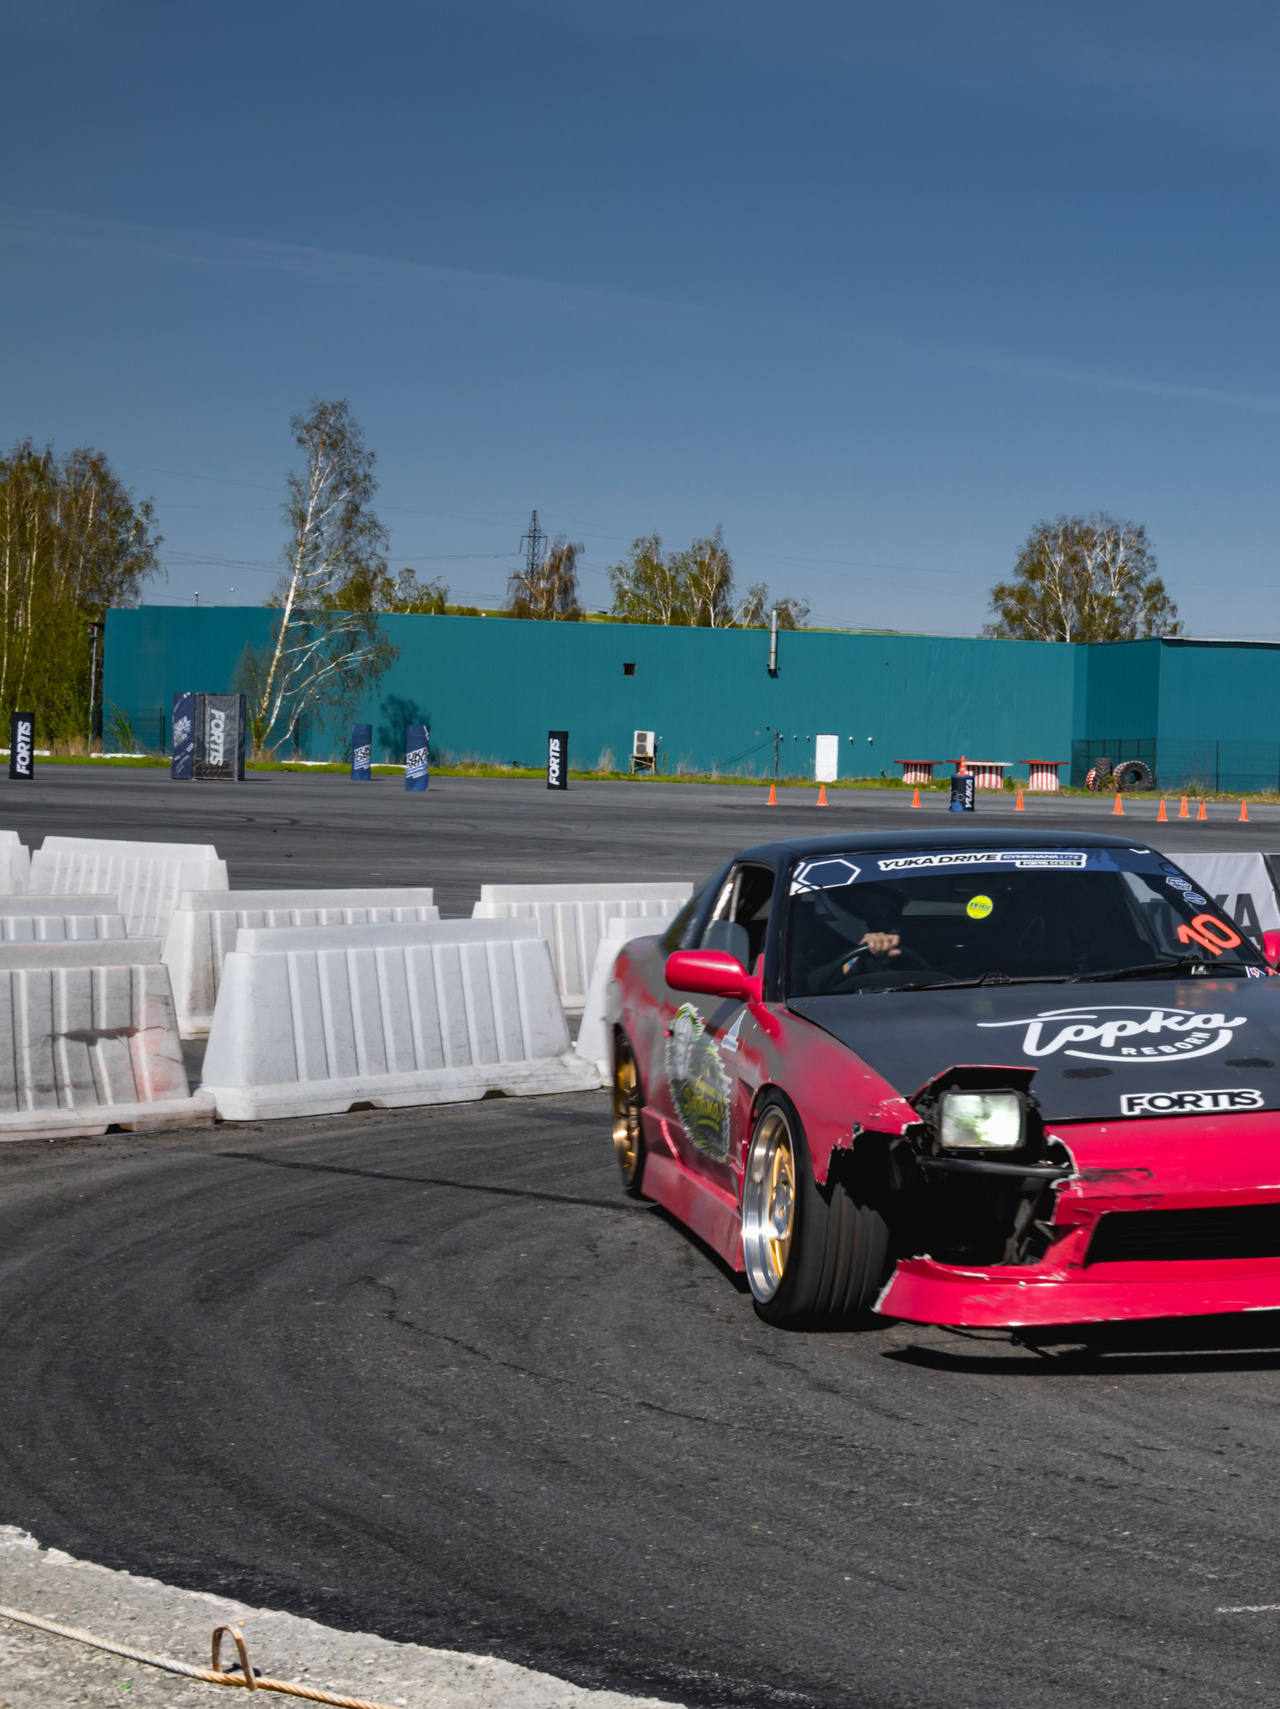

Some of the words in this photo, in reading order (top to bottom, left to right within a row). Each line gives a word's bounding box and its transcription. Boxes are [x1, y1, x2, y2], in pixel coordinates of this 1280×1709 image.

[16, 720, 32, 775] FORTIS
[209, 708, 226, 767] FORTIS
[549, 738, 561, 785] FORTIS
[965, 779, 973, 808] YUKA
[882, 857, 933, 868] YUKA
[938, 854, 998, 863] DRIVE
[1177, 914, 1241, 956] 10
[1121, 1031, 1211, 1056] REBORN
[1125, 1090, 1261, 1114] FORTIS
